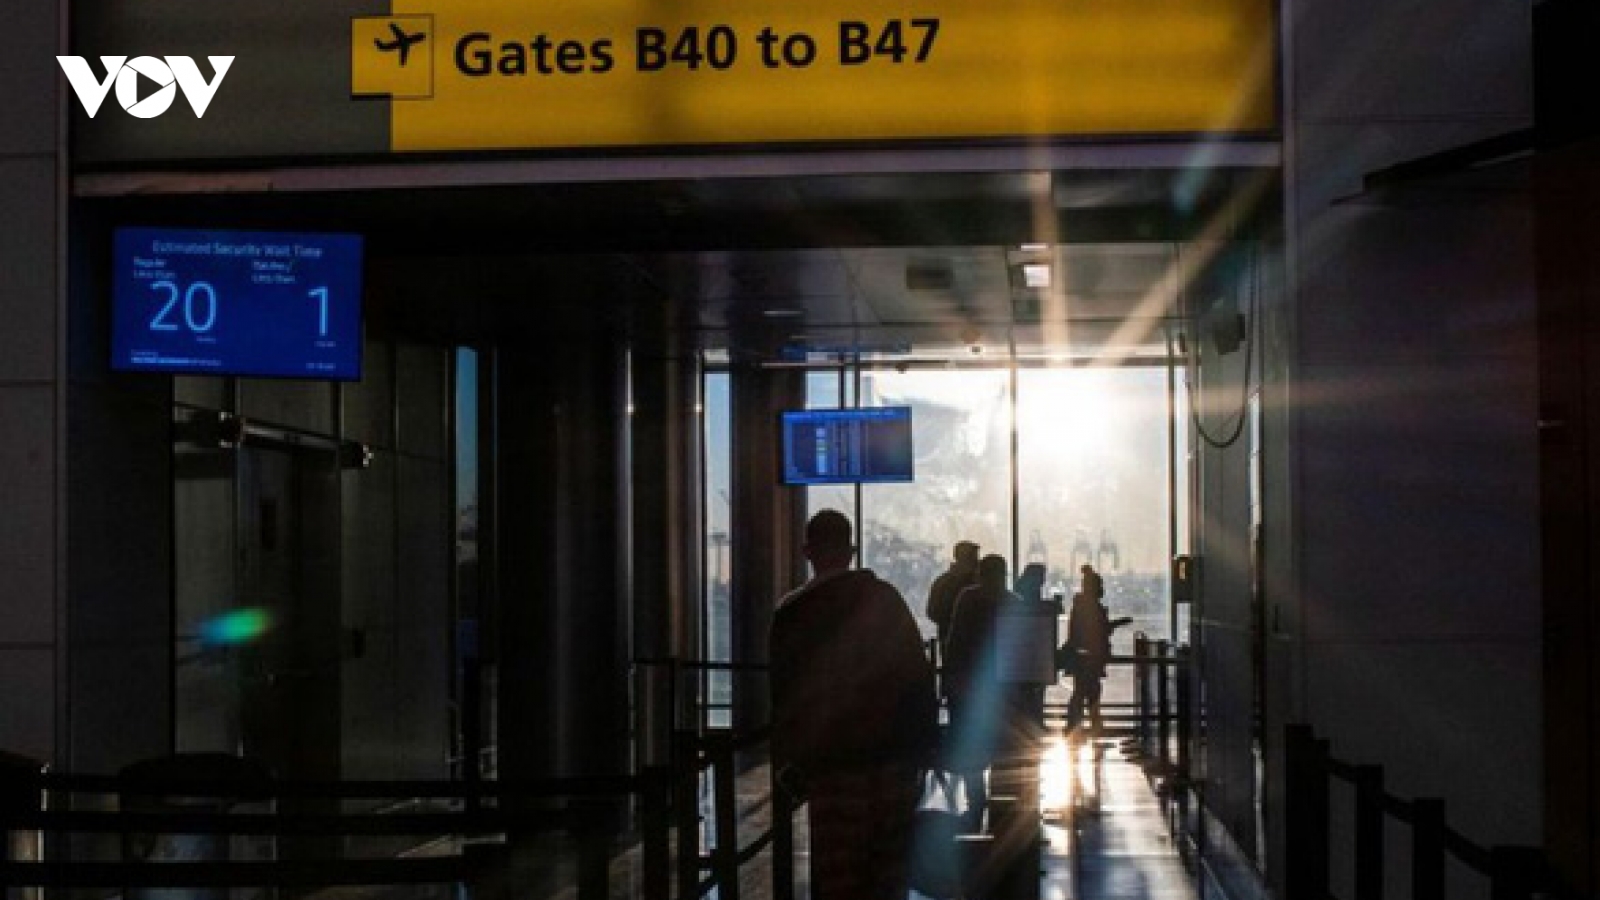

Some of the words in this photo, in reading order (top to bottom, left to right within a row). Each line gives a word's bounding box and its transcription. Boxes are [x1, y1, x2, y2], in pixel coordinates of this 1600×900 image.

[454, 31, 614, 77] Gates
[635, 25, 738, 71] B40
[757, 28, 817, 69] to
[838, 18, 940, 65] B47
[153, 240, 211, 254] Estimated
[213, 241, 261, 257] Security
[264, 244, 290, 256] Wait
[294, 244, 322, 257] Time
[149, 280, 217, 334] 20
[308, 286, 329, 337] 1
